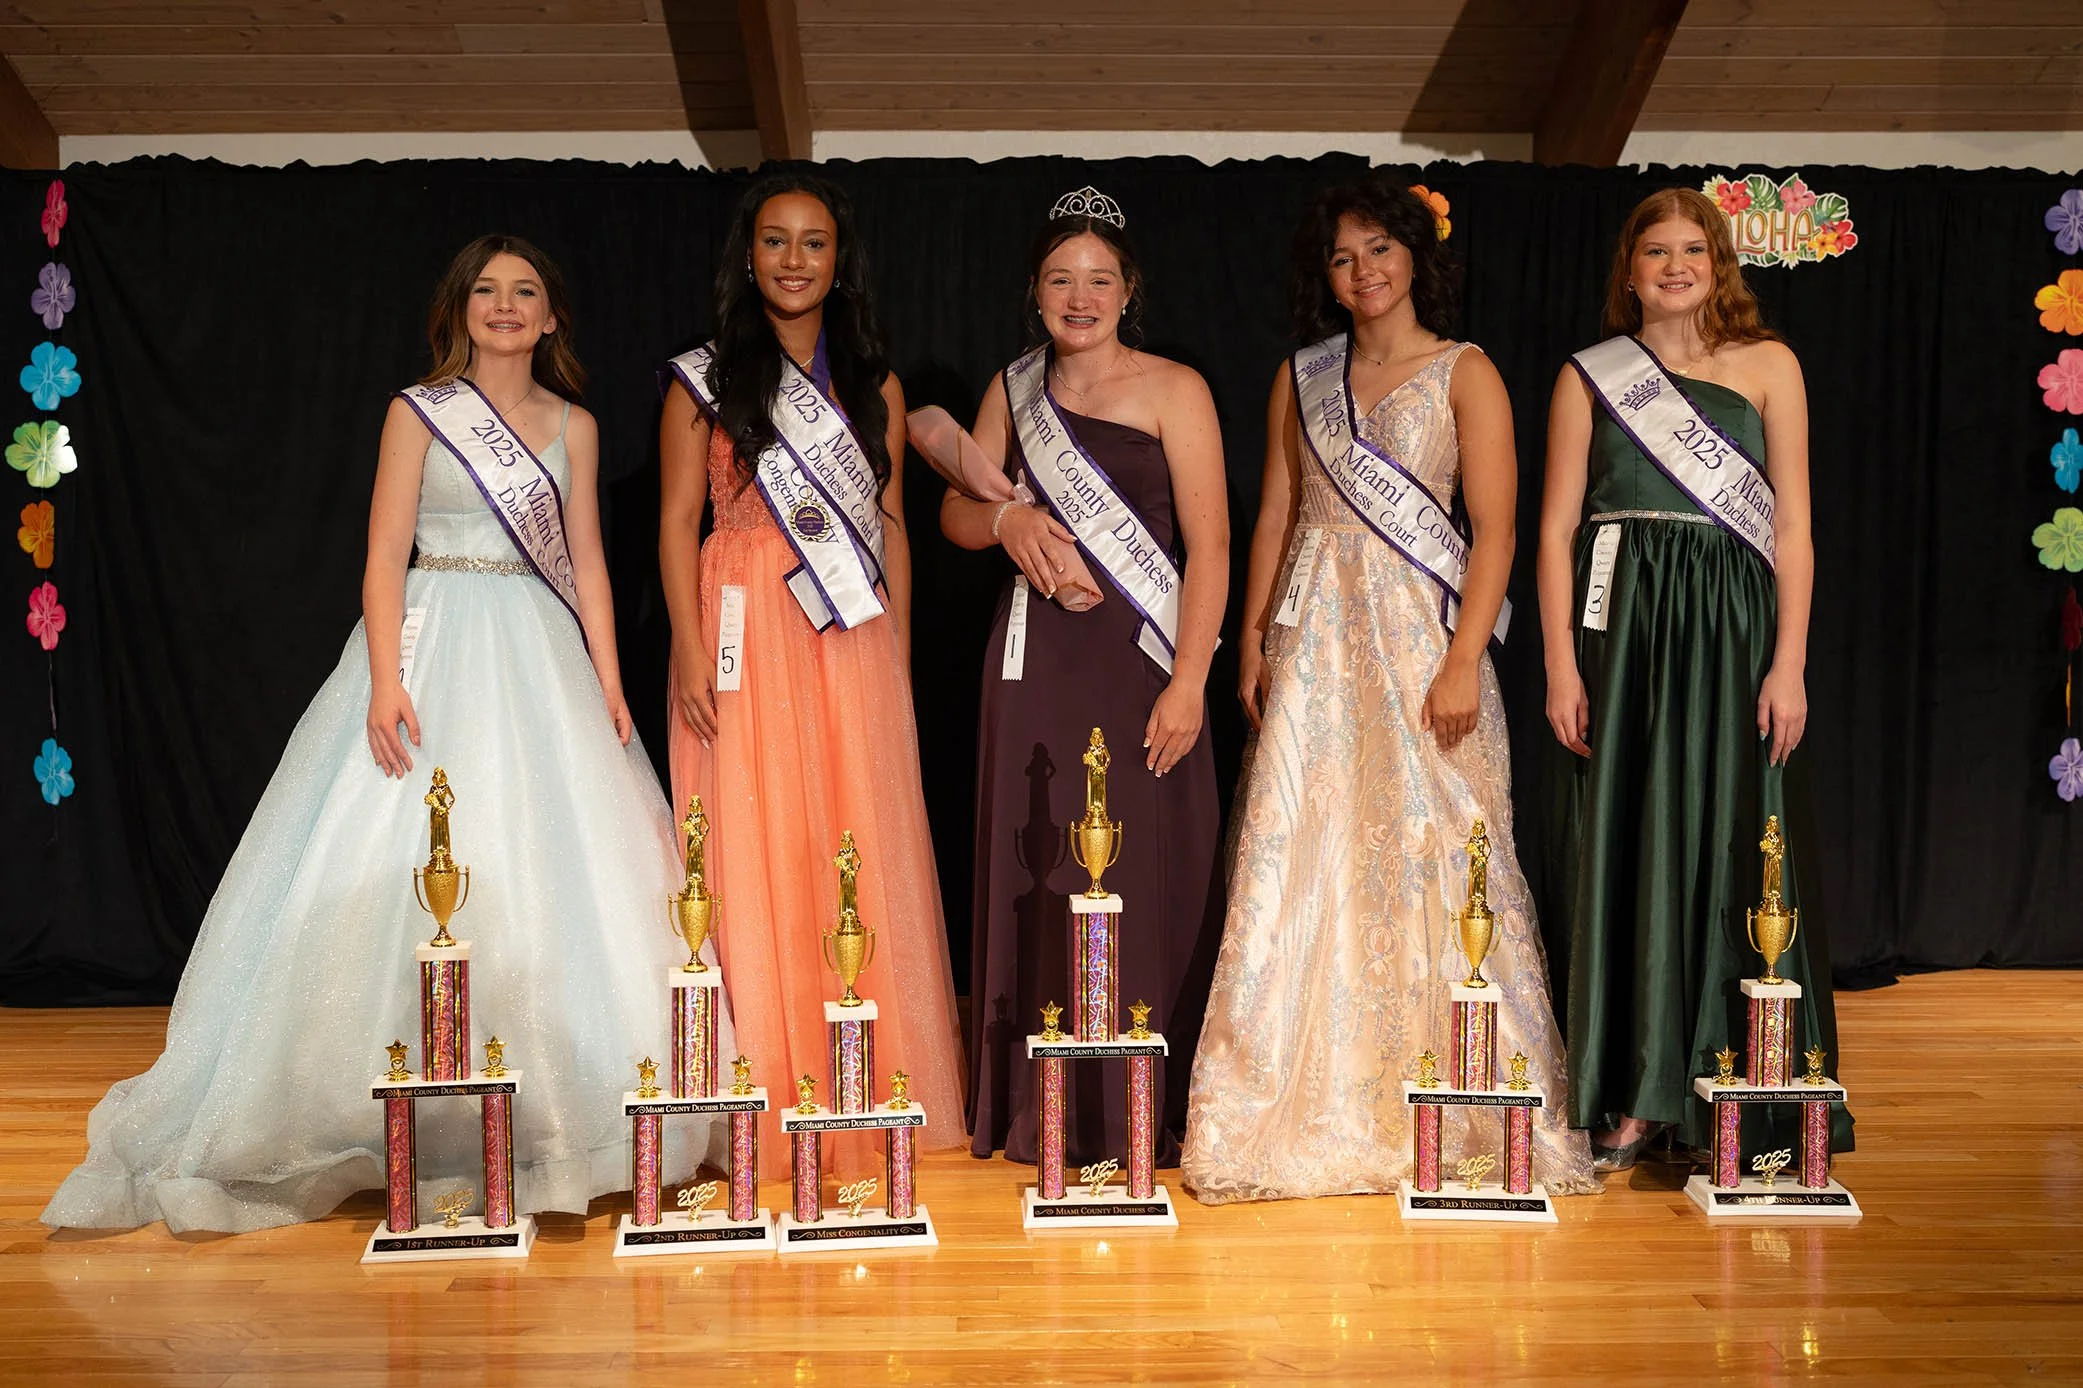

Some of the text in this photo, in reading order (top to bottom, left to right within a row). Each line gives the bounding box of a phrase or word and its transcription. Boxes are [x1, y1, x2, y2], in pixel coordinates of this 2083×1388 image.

[777, 378, 876, 501] 2025 Miami
[1321, 389, 1346, 437] 2025
[1340, 443, 1411, 508] Miami
[1673, 419, 1730, 470] 2025
[470, 419, 524, 467] 2025
[519, 475, 560, 546] Miami
[761, 447, 798, 510] Congeni
[803, 442, 848, 501] Duchess
[497, 486, 534, 546] Duchess
[1055, 490, 1086, 524] 2025
[1056, 450, 1110, 519] County
[1111, 515, 1173, 594] Duchess
[1329, 456, 1418, 549] Duchess Court
[1709, 488, 1760, 539] Duchess
[1288, 584, 1300, 612] 4
[1588, 584, 1605, 614] 3
[721, 645, 736, 674] 5
[1080, 1158, 1118, 1182] 2025
[1457, 1153, 1496, 1176] 2025
[1752, 1148, 1792, 1171] 2025
[677, 1180, 718, 1207] 2025
[838, 1177, 878, 1204] 2025
